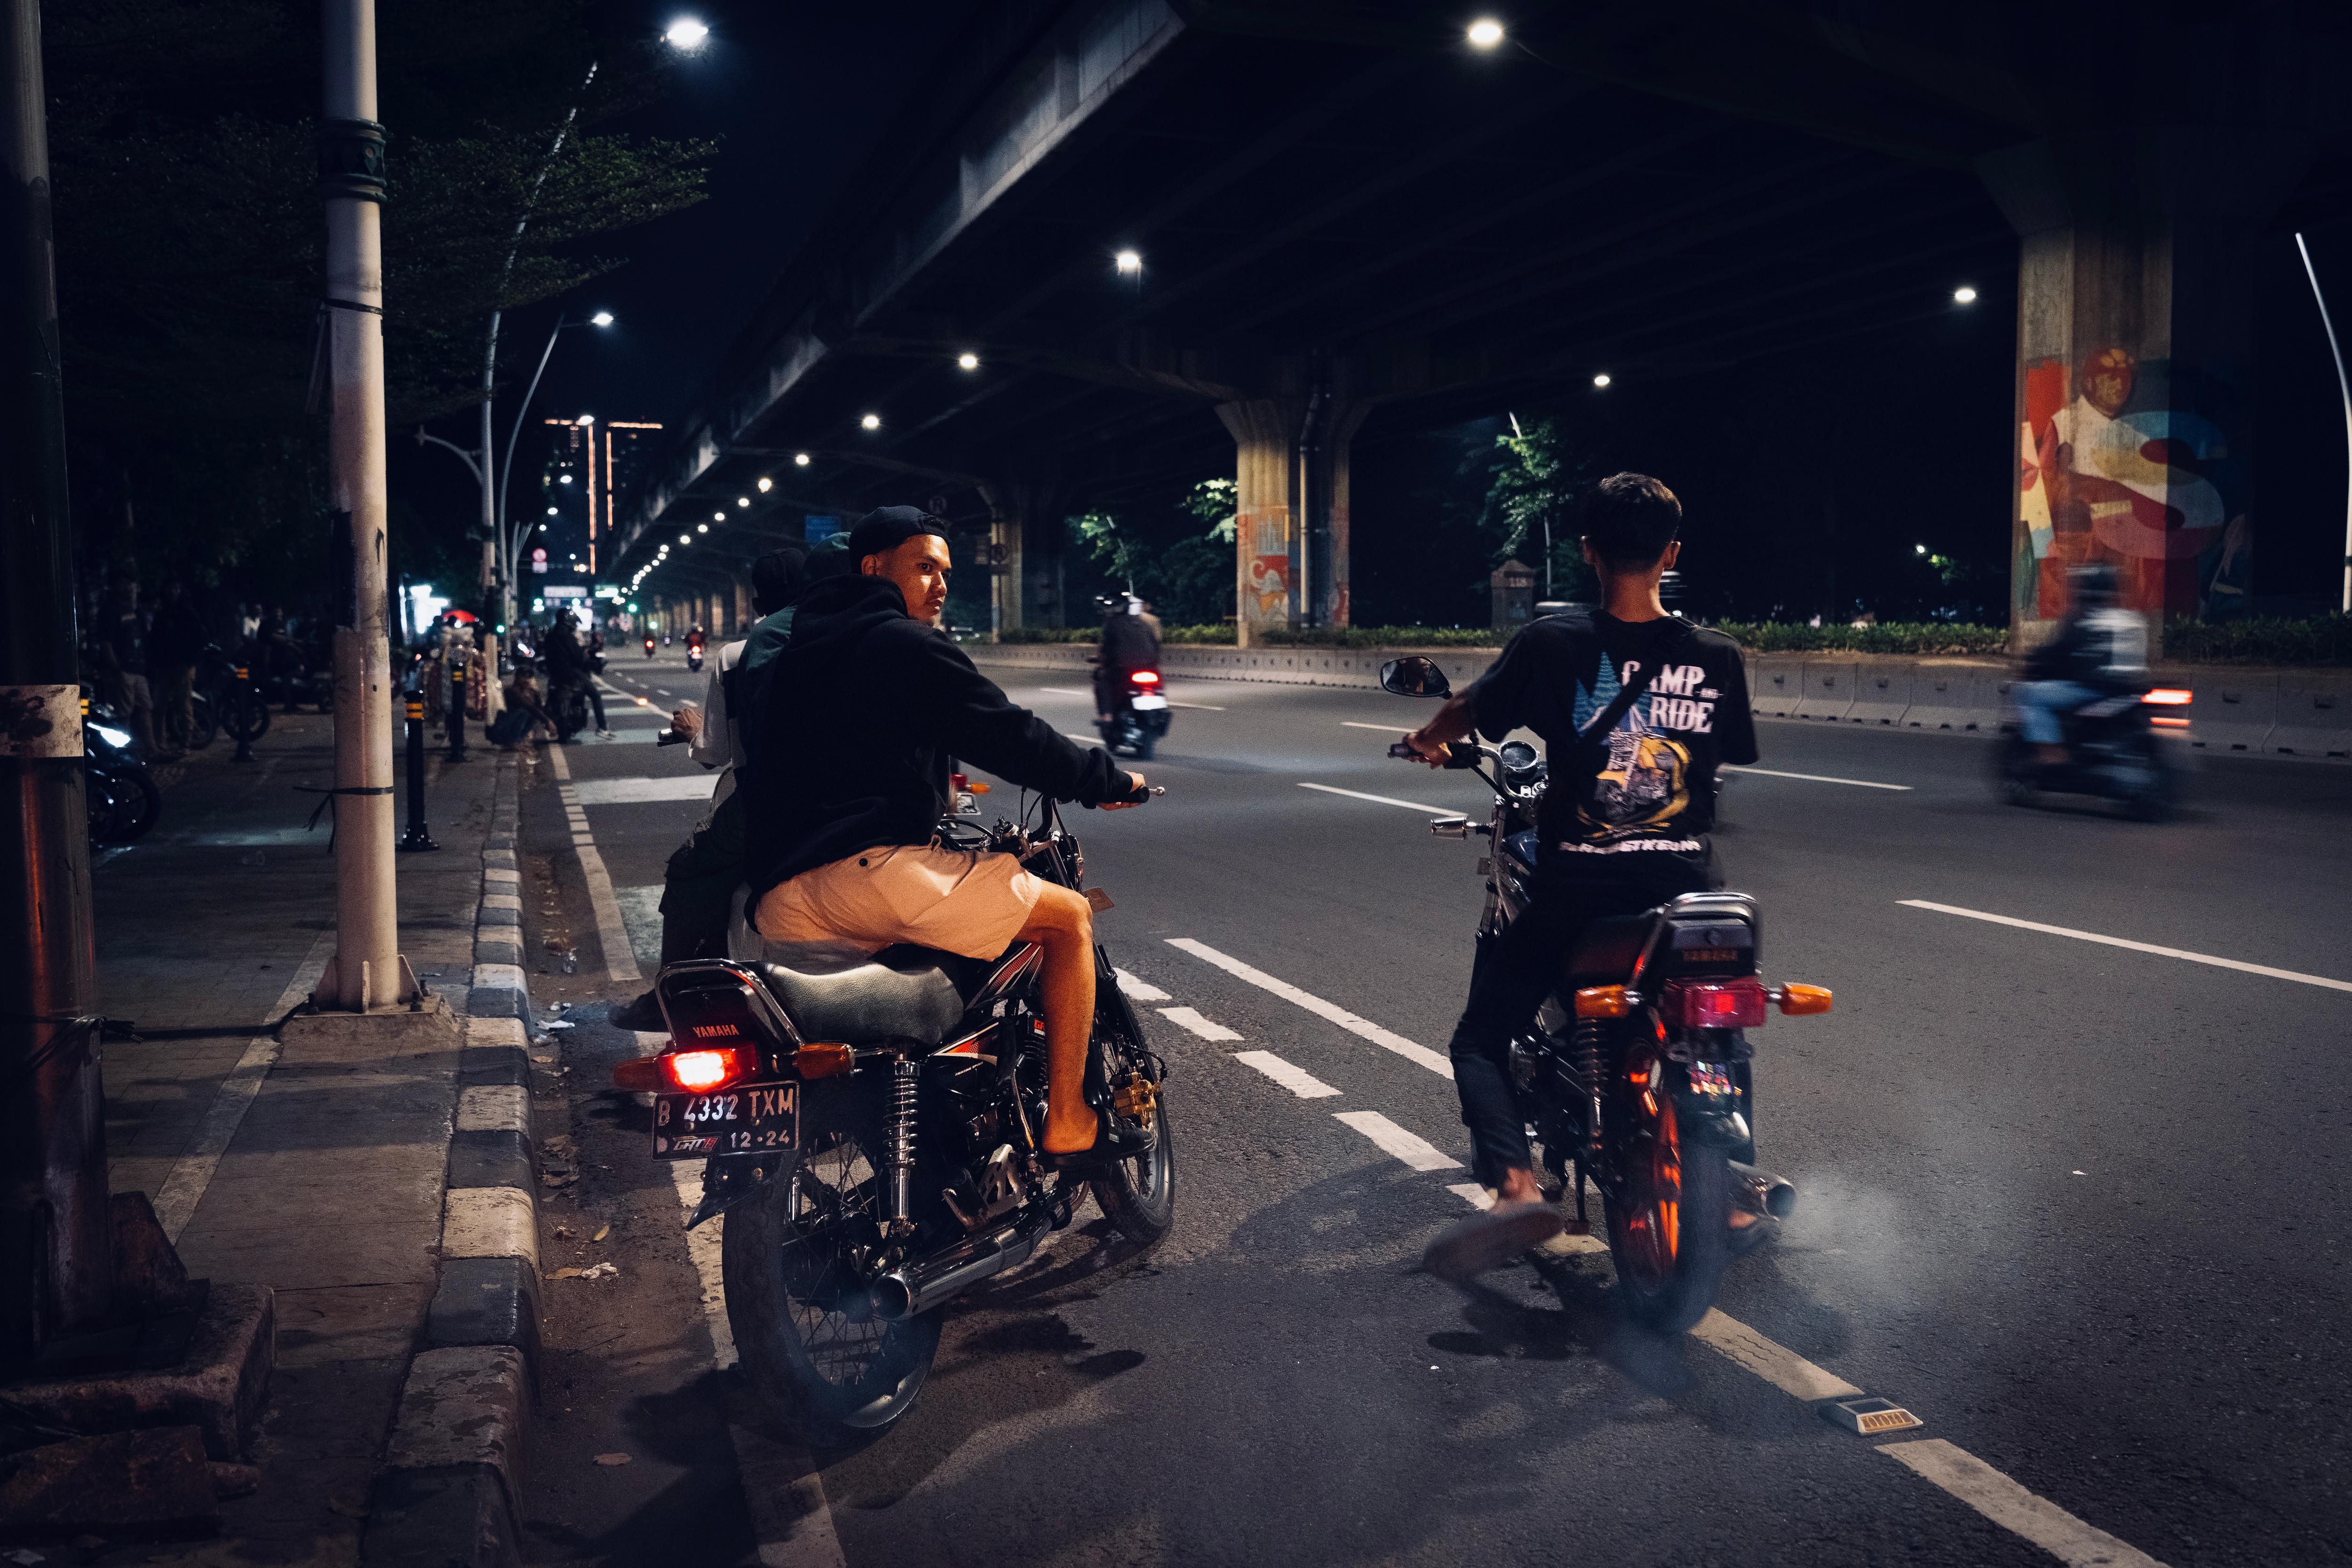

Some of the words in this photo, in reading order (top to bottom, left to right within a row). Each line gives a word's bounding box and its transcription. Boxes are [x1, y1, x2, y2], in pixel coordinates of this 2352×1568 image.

[1649, 696, 1715, 733] RIDE
[693, 1024, 739, 1038] YAMAHA
[658, 1100, 670, 1126] B
[683, 1094, 738, 1122] 4332
[748, 1088, 794, 1117] TXM
